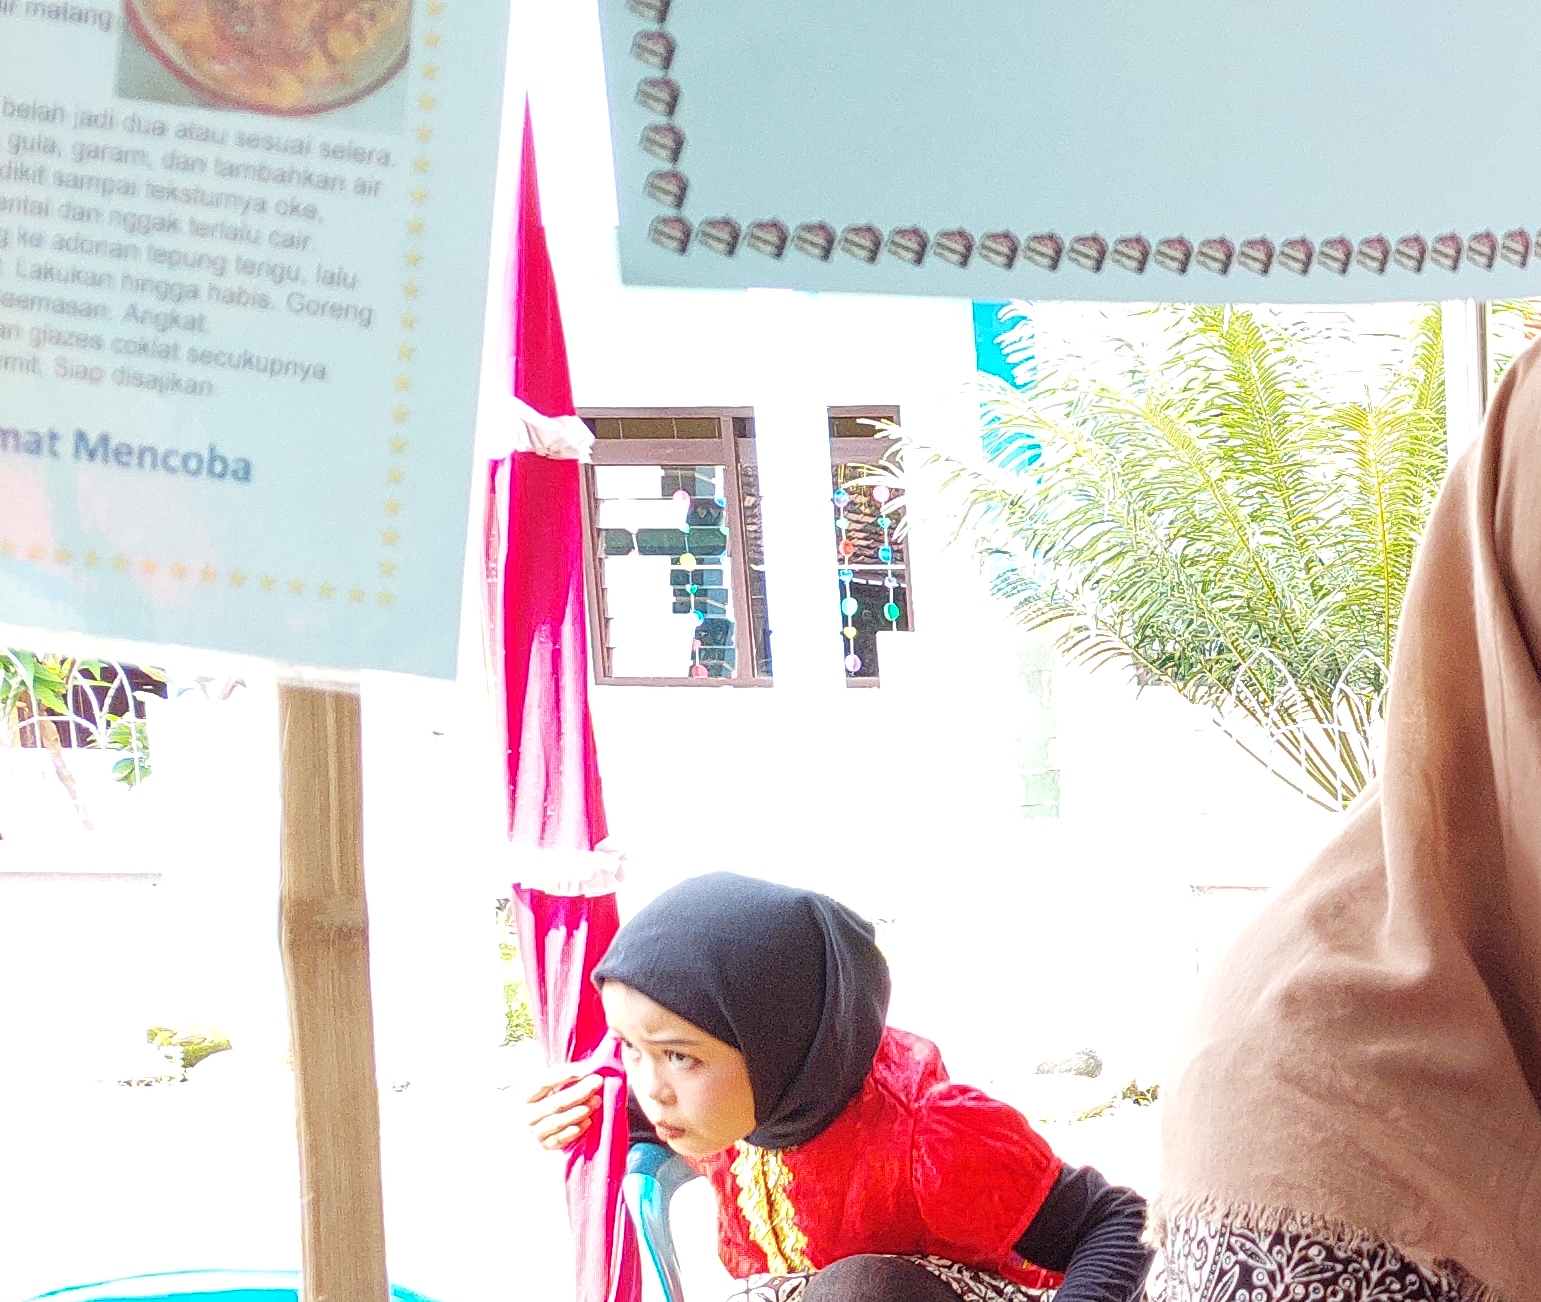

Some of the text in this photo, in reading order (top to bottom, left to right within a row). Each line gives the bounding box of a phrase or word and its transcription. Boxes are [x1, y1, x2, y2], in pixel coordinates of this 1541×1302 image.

[123, 111, 168, 136] dua
[175, 119, 226, 146] atau
[235, 130, 311, 156] sesuai
[53, 168, 137, 197] sampai
[161, 148, 207, 173] dan
[214, 156, 346, 192] tambahkan
[353, 174, 384, 198] air
[57, 199, 103, 223] dan
[17, 225, 44, 247] ke
[52, 234, 139, 261] adonan
[147, 245, 227, 277] tepung
[316, 263, 358, 290] lalu
[16, 257, 115, 290] Lakukan
[120, 272, 200, 303] hingga
[286, 291, 375, 328] Goreng
[54, 356, 106, 383] Siap
[111, 363, 215, 398] disajikan
[111, 334, 181, 362] coklat
[187, 345, 327, 380] secukupnya
[73, 427, 253, 484] Mencoba
